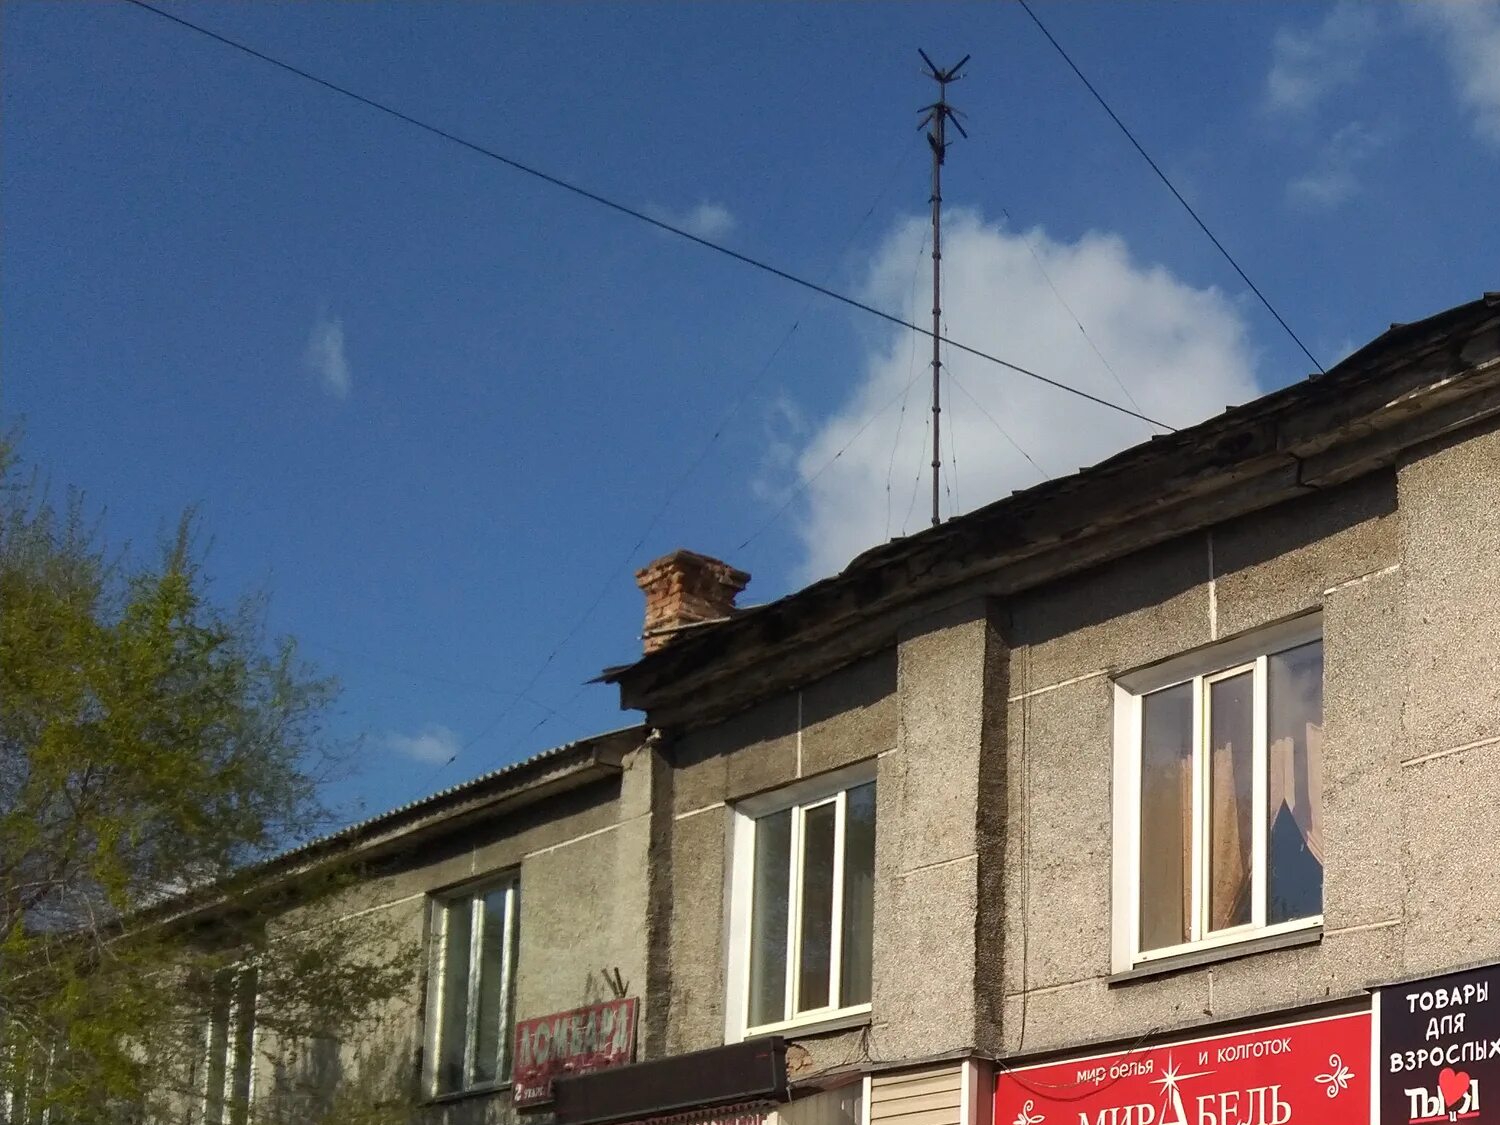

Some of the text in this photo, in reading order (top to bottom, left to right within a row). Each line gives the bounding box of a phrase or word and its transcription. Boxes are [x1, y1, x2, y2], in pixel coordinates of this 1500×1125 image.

[1405, 981, 1489, 1013] ТОВАРЫ
[519, 1003, 629, 1067] ЛОМБАРД
[1425, 1012, 1466, 1041] ДЛЯ
[1077, 1066, 1107, 1086] мир
[1109, 1059, 1154, 1080] белья
